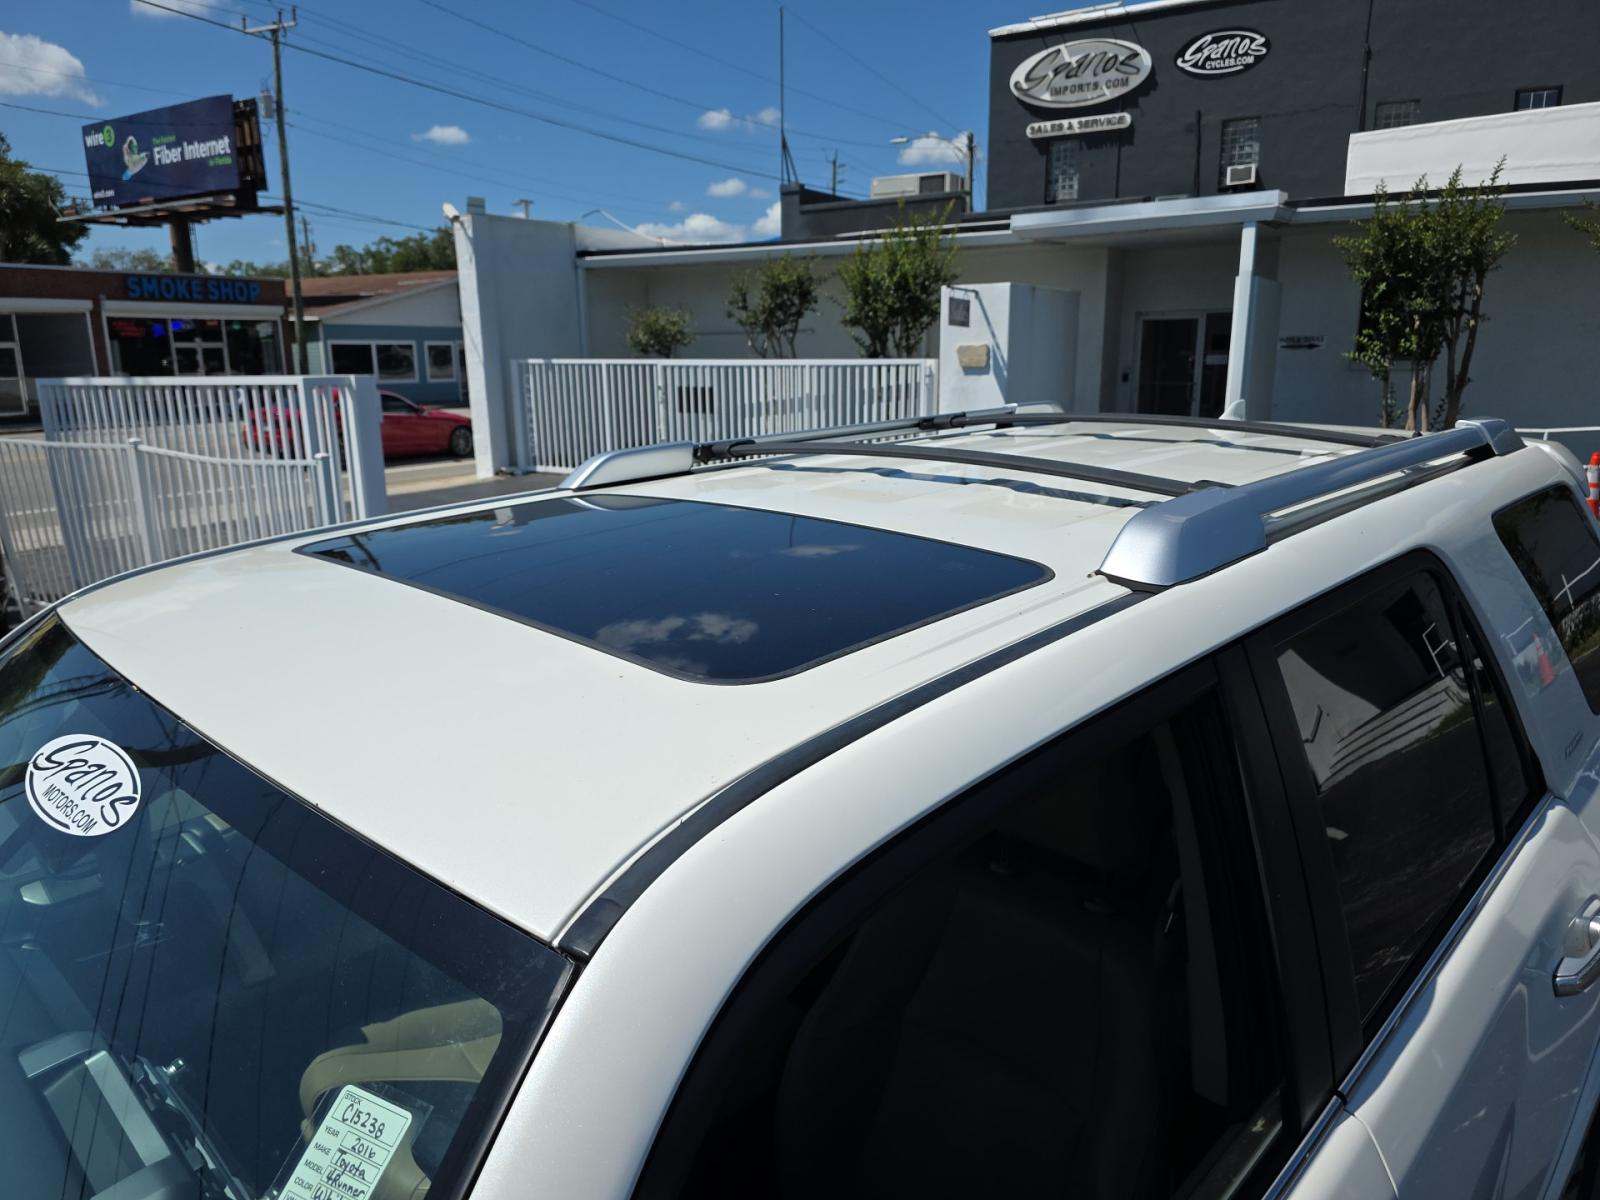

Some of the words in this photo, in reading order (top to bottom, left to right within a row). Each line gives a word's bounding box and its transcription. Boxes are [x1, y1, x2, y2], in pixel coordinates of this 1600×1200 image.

[1205, 55, 1255, 69] CYCLES.COM
[1029, 122, 1064, 136] SALES
[1066, 121, 1075, 131] &
[1077, 115, 1127, 130] SERVICE
[153, 144, 182, 166] Fiber
[183, 135, 231, 161] Internet
[128, 276, 205, 300] SMOKE
[207, 280, 262, 303] SHOP
[42, 784, 98, 835] MOTORS.COM
[344, 1094, 362, 1106] STOCK
[341, 1102, 386, 1139] C15238
[324, 1126, 340, 1137] YEAR
[313, 1142, 332, 1156] MAKE
[350, 1137, 377, 1159] 2016
[304, 1159, 323, 1174] MODEL
[336, 1148, 368, 1182] Toyota
[293, 1177, 313, 1192] COLOR
[326, 1167, 366, 1197] 4Runner
